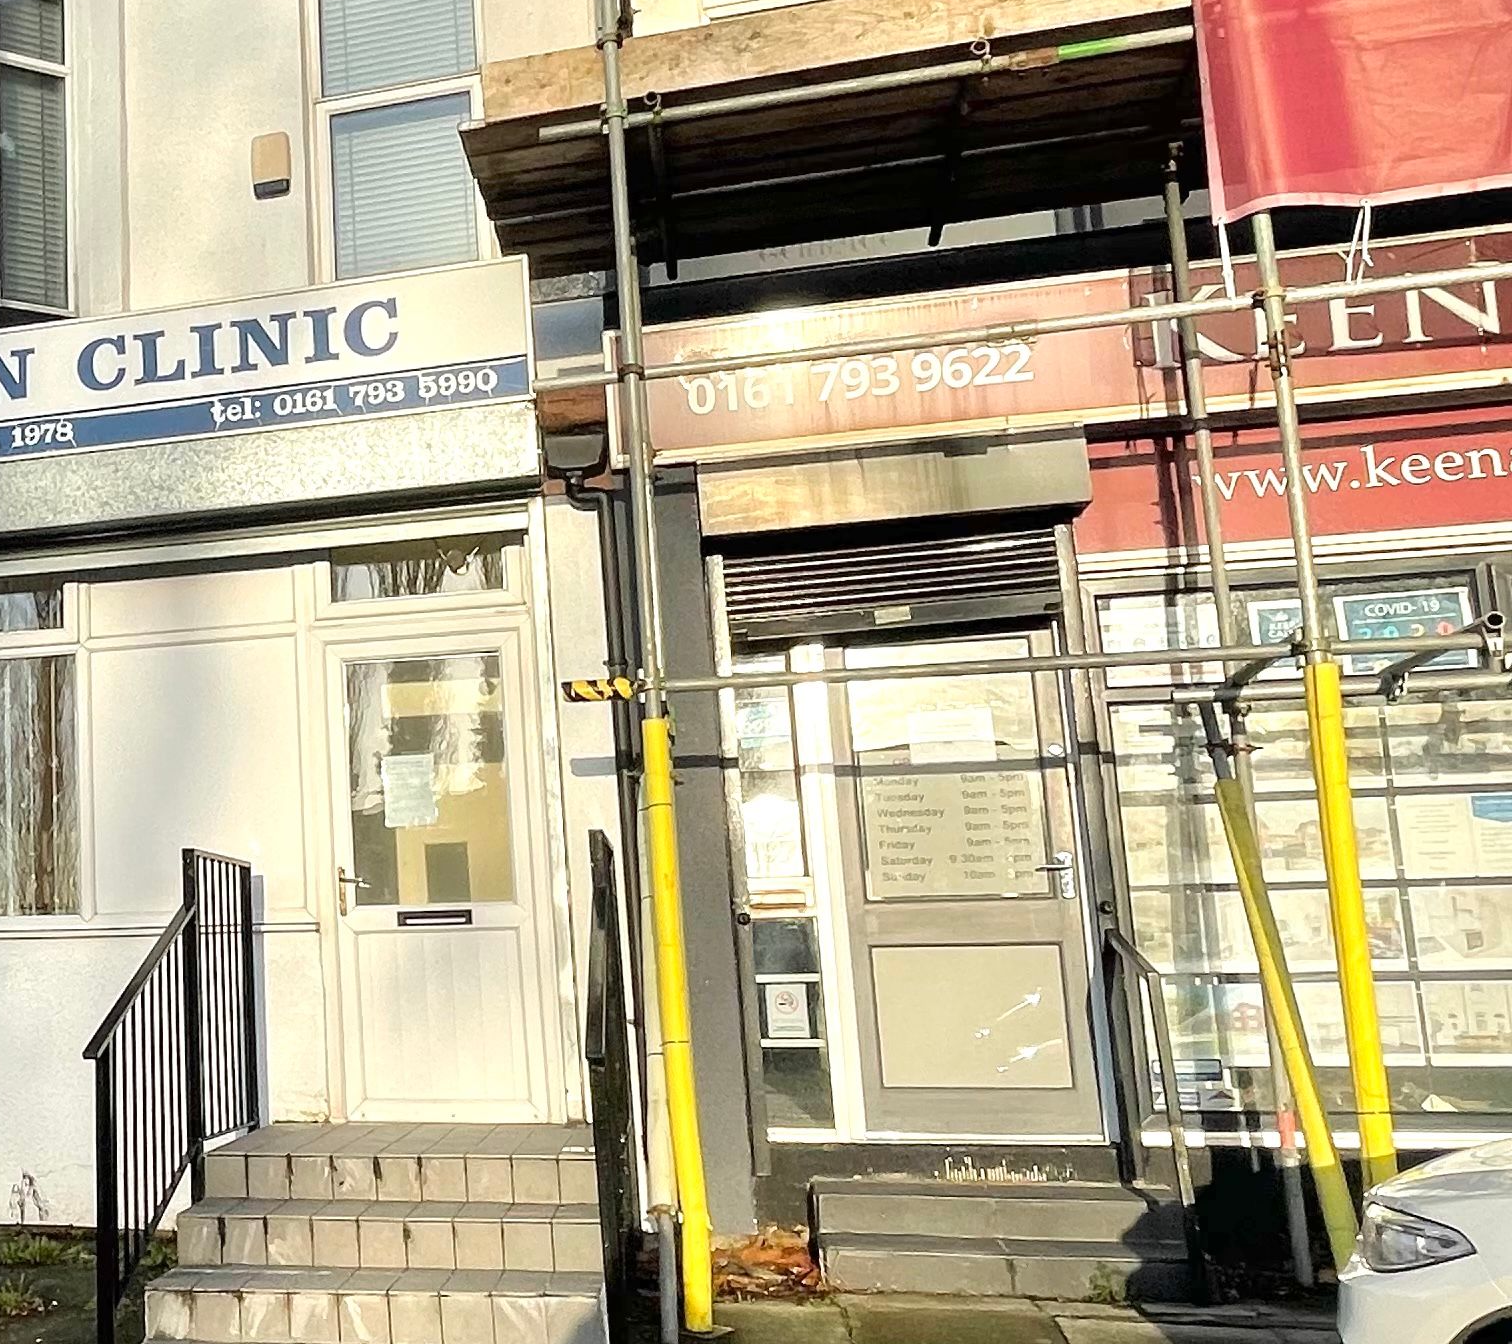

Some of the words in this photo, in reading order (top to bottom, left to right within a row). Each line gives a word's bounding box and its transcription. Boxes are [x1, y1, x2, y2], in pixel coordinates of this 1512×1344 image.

[77, 297, 400, 391] CLINIC
[810, 358, 900, 402] 793
[911, 343, 1035, 392] 9622
[211, 398, 262, 426] tel:
[273, 385, 339, 416] 0161
[349, 380, 405, 407] 793
[418, 368, 498, 399] 5990
[11, 420, 75, 451] 1978
[1192, 445, 1512, 501] www.keen
[876, 807, 945, 819] Wednesday
